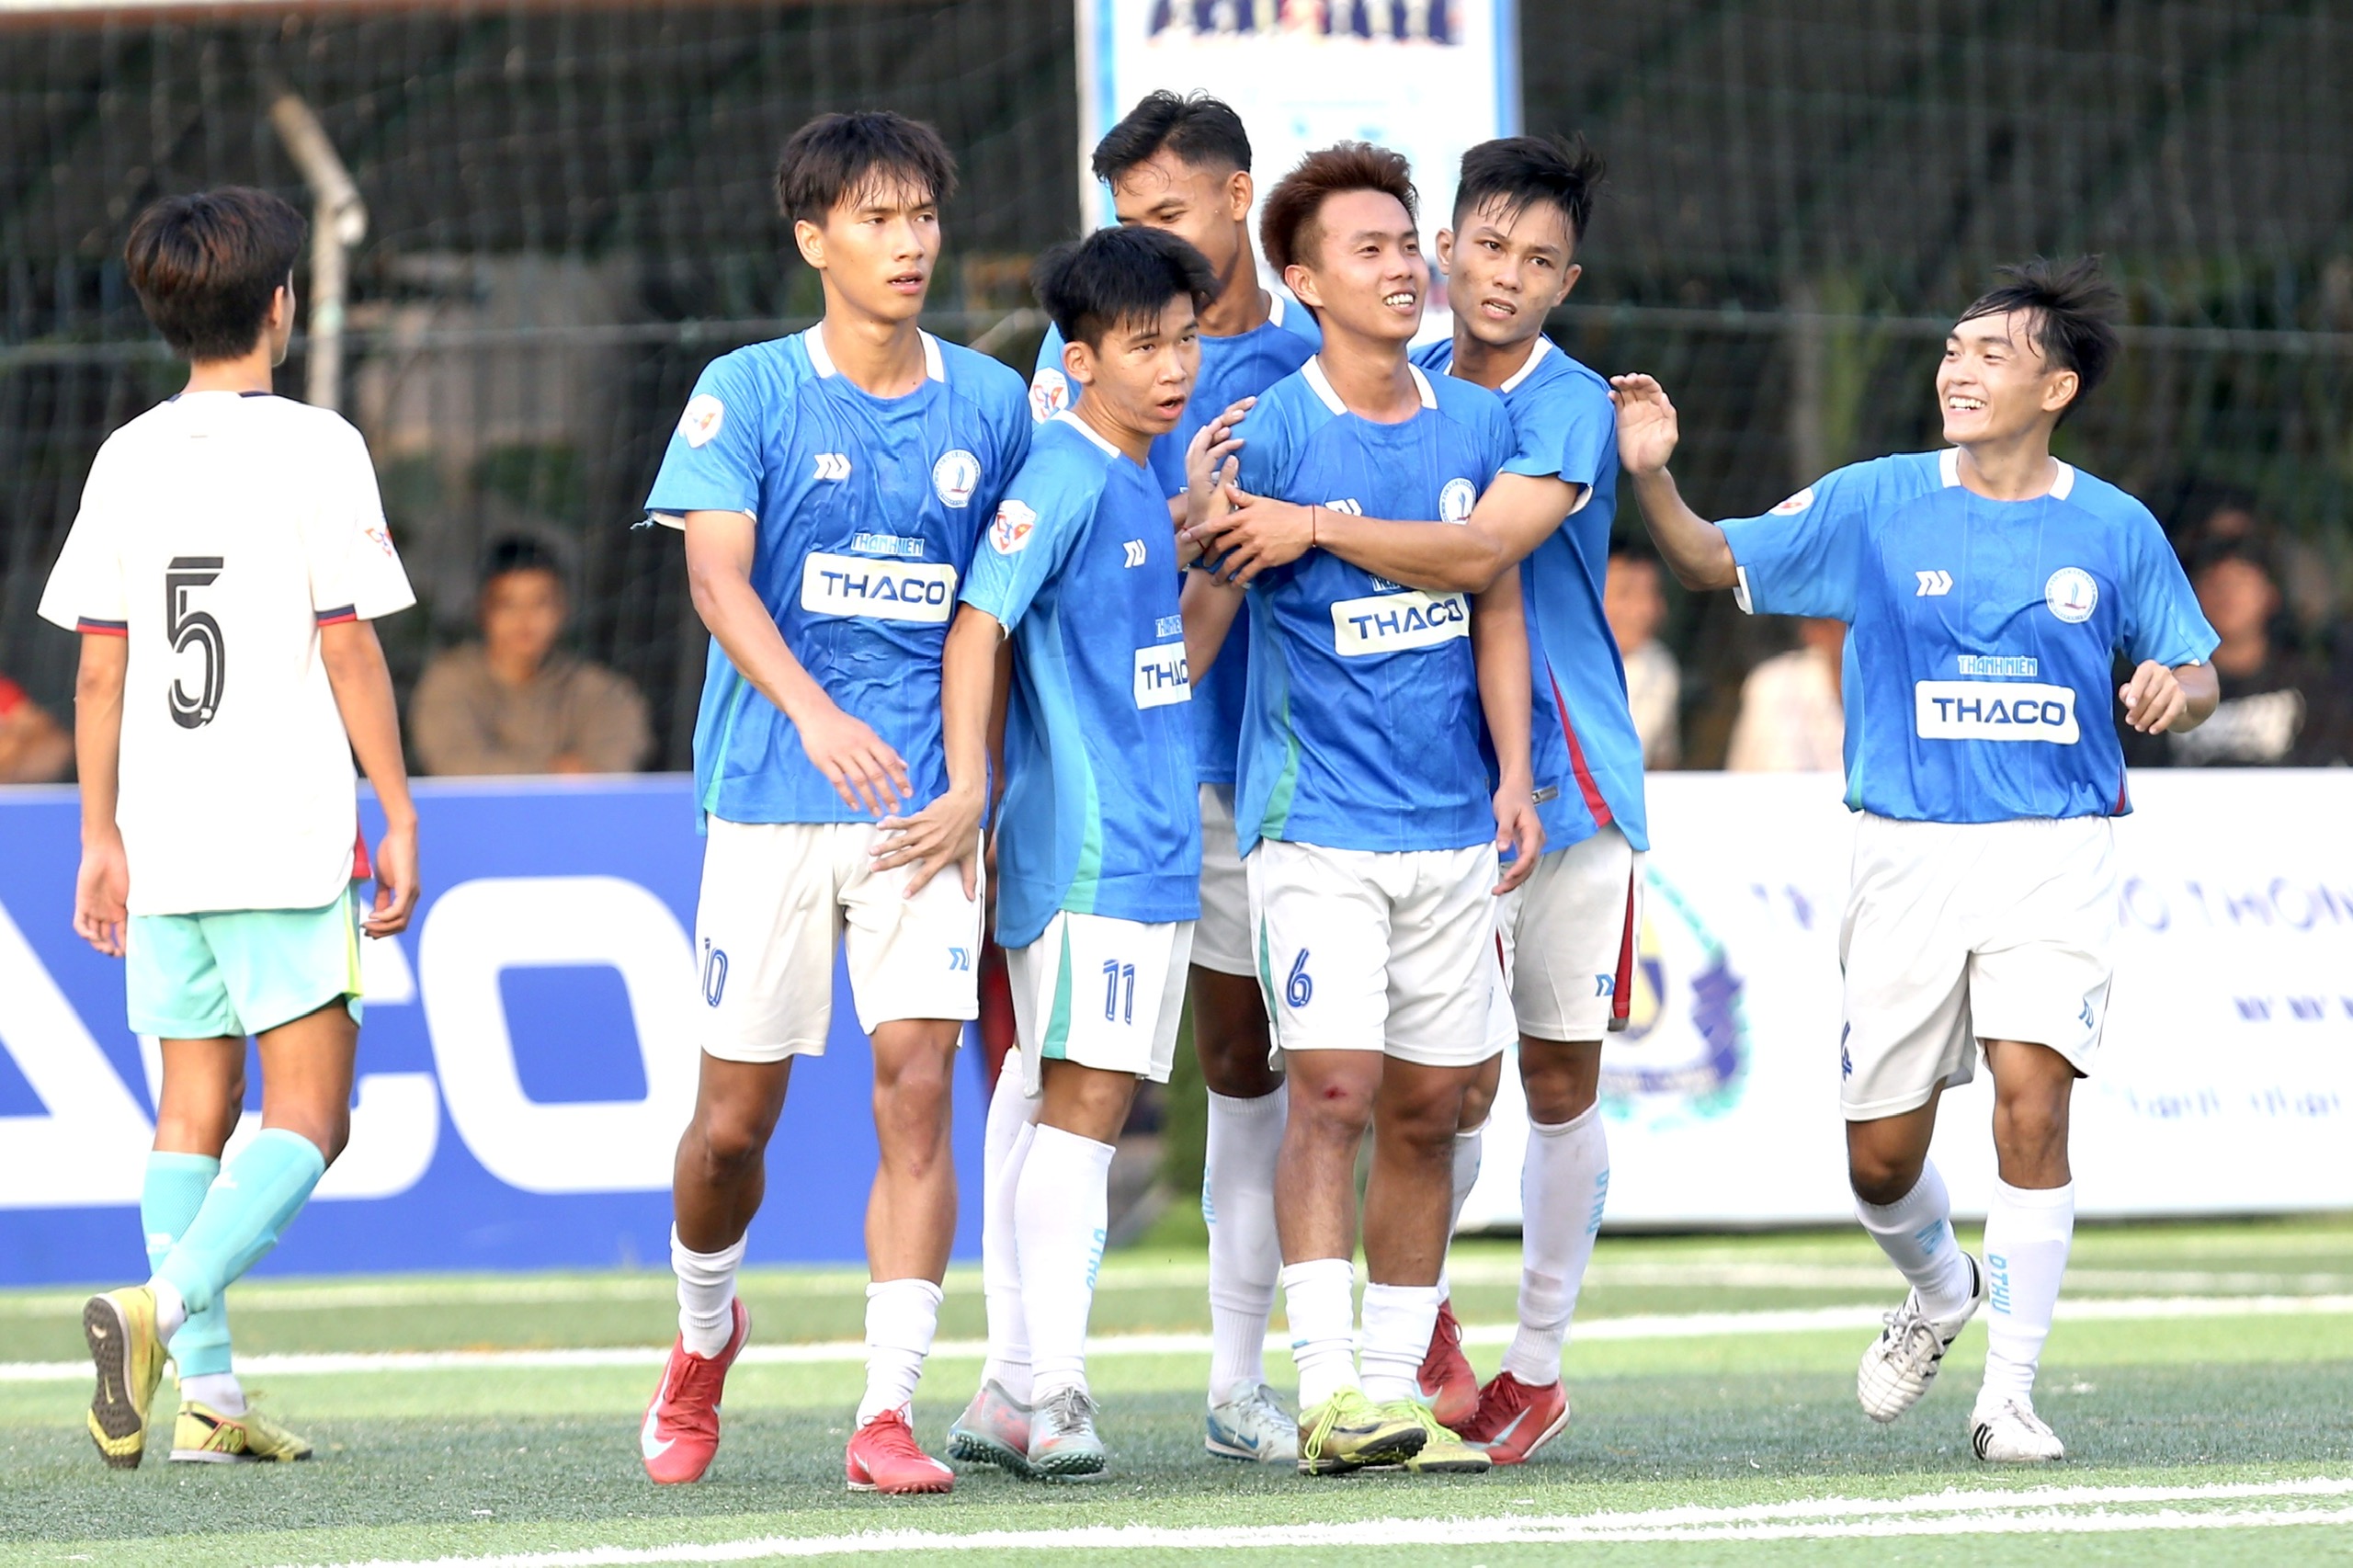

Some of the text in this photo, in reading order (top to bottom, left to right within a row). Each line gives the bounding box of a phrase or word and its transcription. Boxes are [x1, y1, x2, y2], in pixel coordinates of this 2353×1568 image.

[820, 570, 946, 606] THACO
[1348, 598, 1464, 640] THACO
[165, 556, 225, 730] 5
[1141, 658, 1189, 690] THAC
[1958, 654, 2004, 676] THANH
[1931, 697, 2066, 726] THACO
[1102, 959, 1135, 1027] 11
[1287, 948, 1313, 1007] 6
[1988, 1253, 2012, 1315] DTHU
